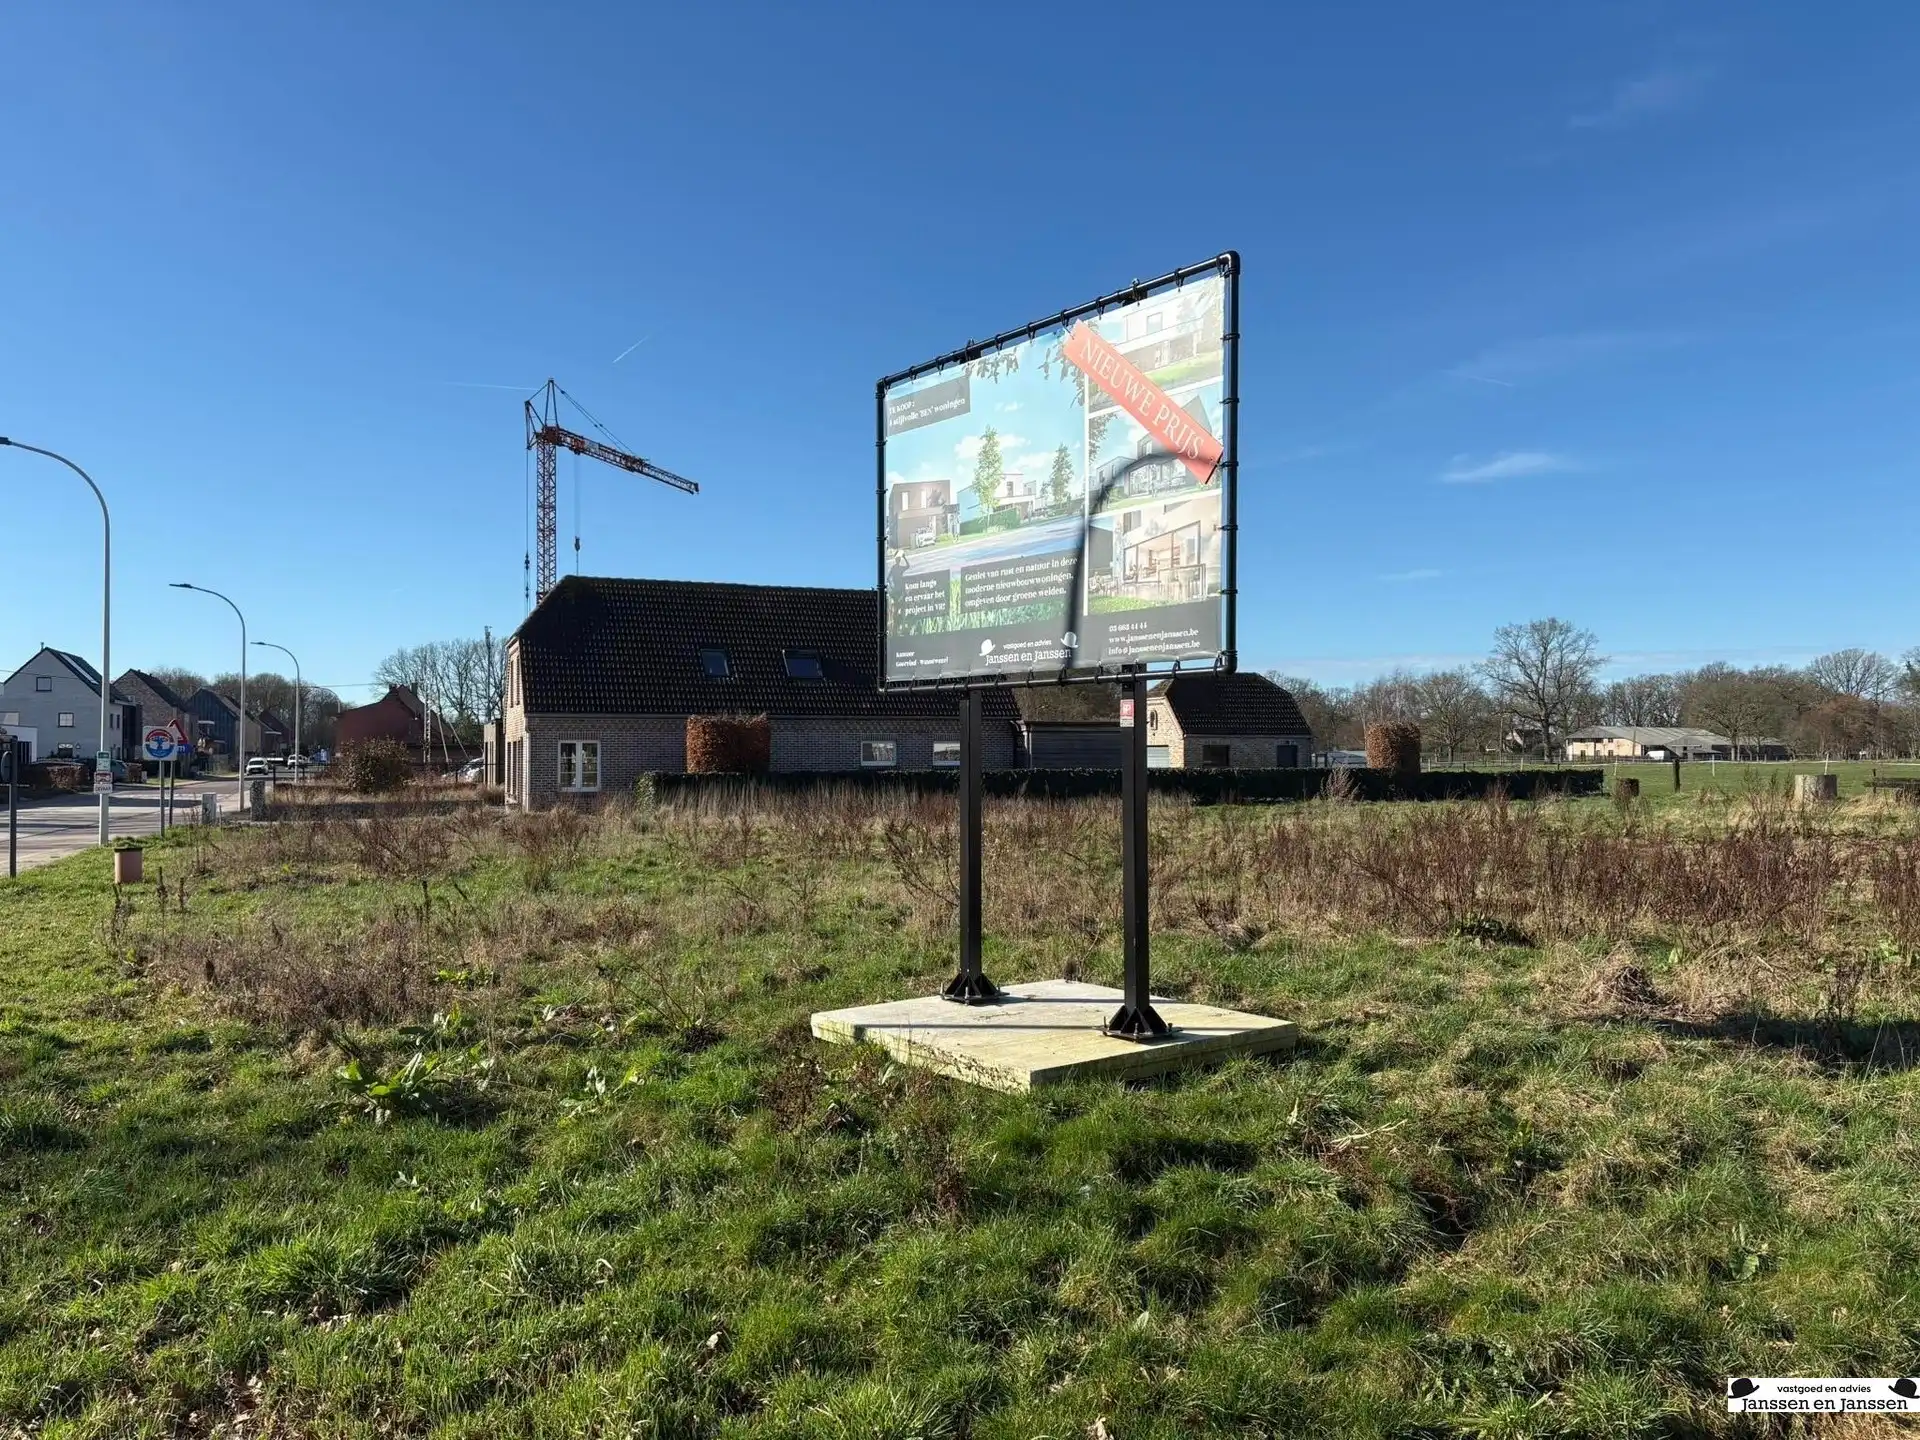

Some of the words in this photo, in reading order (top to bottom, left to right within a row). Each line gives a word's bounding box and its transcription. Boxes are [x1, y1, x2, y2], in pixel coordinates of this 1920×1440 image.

[1080, 337, 1157, 416] NIEUWE
[1152, 404, 1205, 460] PRIJS
[934, 398, 966, 413] woningen
[965, 572, 986, 581] Geniet
[987, 570, 999, 578] van
[1000, 568, 1014, 576] rust
[1016, 566, 1024, 574] en
[1026, 561, 1050, 572] natuur
[1051, 559, 1059, 568] in
[1060, 557, 1077, 567] deze
[920, 580, 937, 588] langs
[965, 583, 994, 594] moderne
[935, 590, 945, 598] het
[964, 597, 994, 608] omgeven
[995, 594, 1011, 603] door
[1012, 591, 1037, 602] groene
[905, 606, 926, 616] project
[1003, 641, 1027, 650] vastgoed
[985, 654, 1020, 666] Janssen
[1021, 652, 1032, 661] en
[1033, 649, 1071, 662] Janssen
